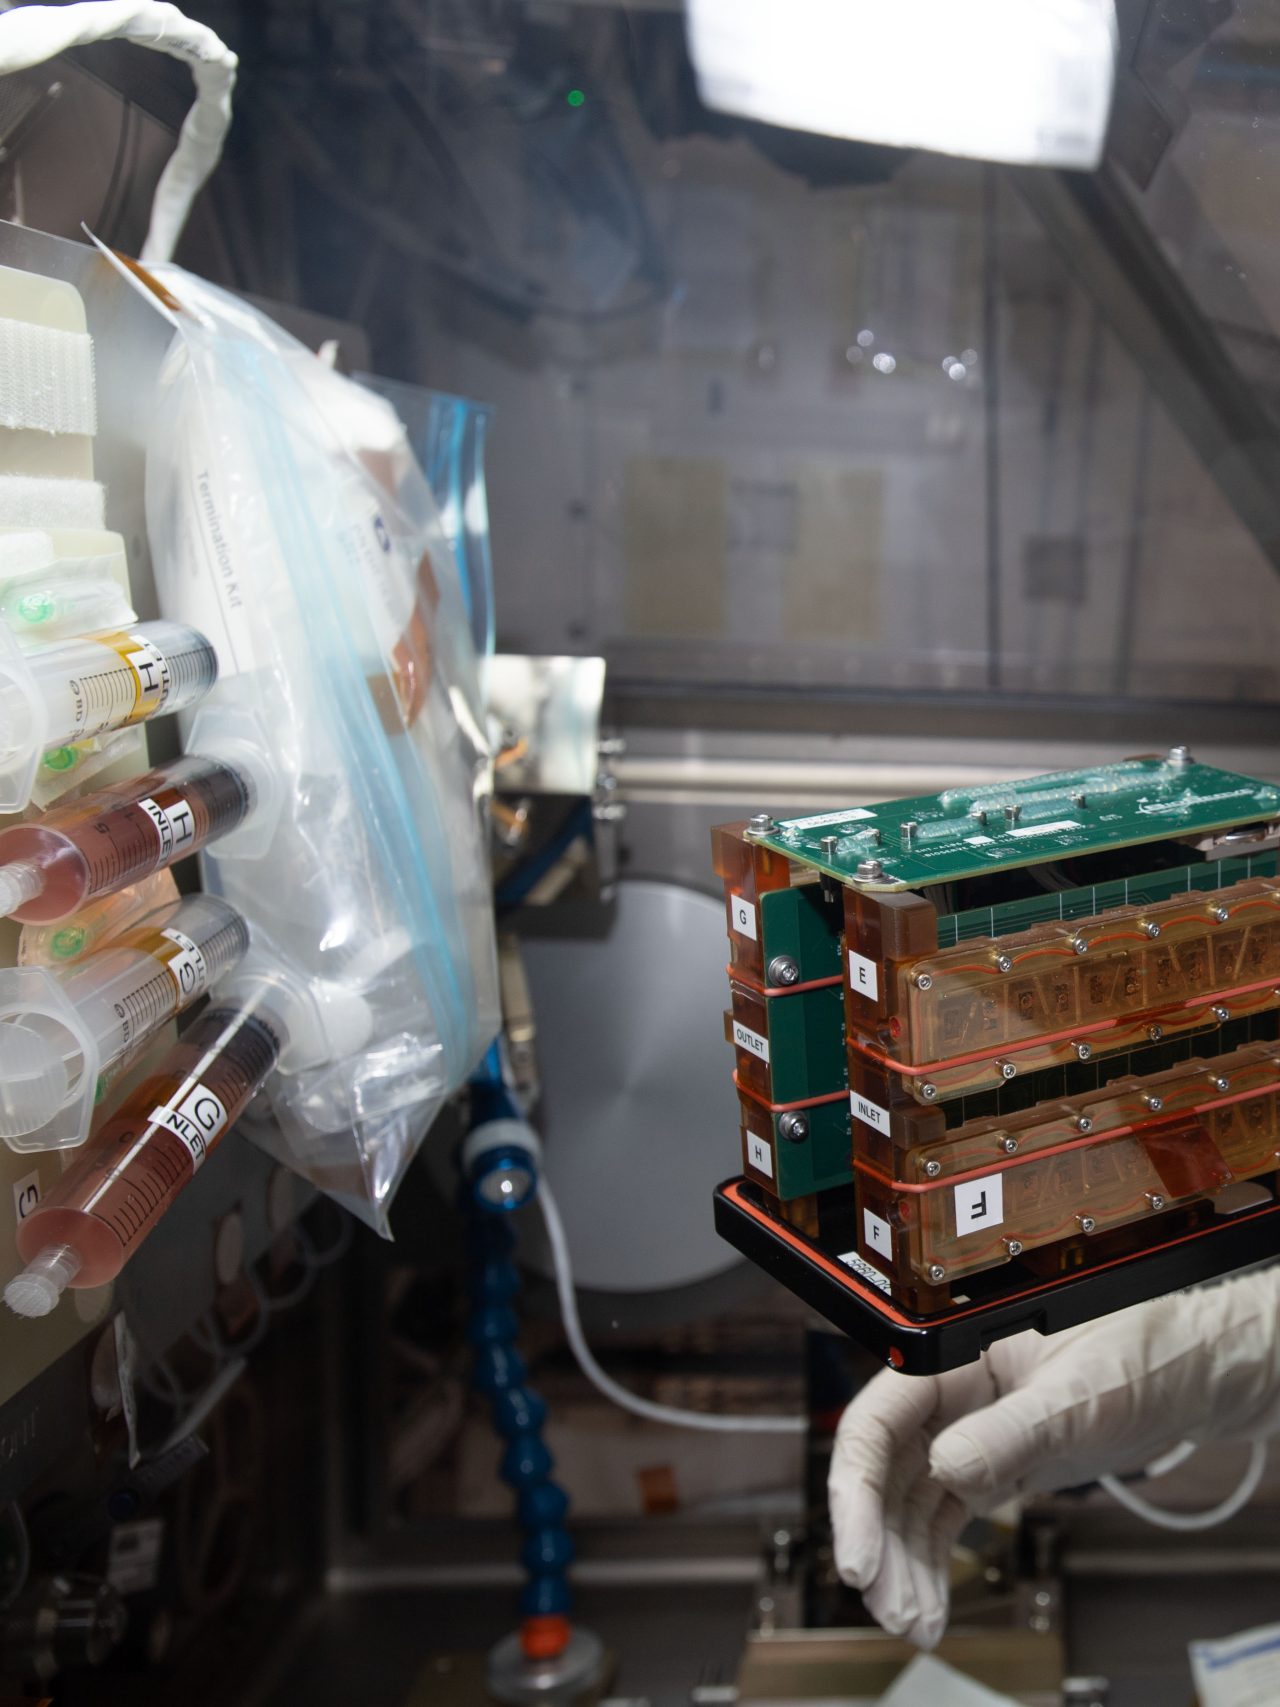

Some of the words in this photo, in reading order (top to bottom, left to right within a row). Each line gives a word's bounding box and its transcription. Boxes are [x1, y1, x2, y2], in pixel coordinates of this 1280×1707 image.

[197, 471, 234, 579] Termination
[226, 580, 243, 610] Kit
[138, 662, 160, 693] H
[173, 811, 192, 844] H
[739, 909, 747, 925] G
[179, 962, 196, 993] G
[859, 966, 867, 985] E
[736, 1028, 764, 1053] OUTLET
[194, 1097, 221, 1132] G
[858, 1101, 881, 1125] INLET
[754, 1145, 763, 1162] H
[970, 1190, 987, 1220] F
[873, 1224, 880, 1240] F
